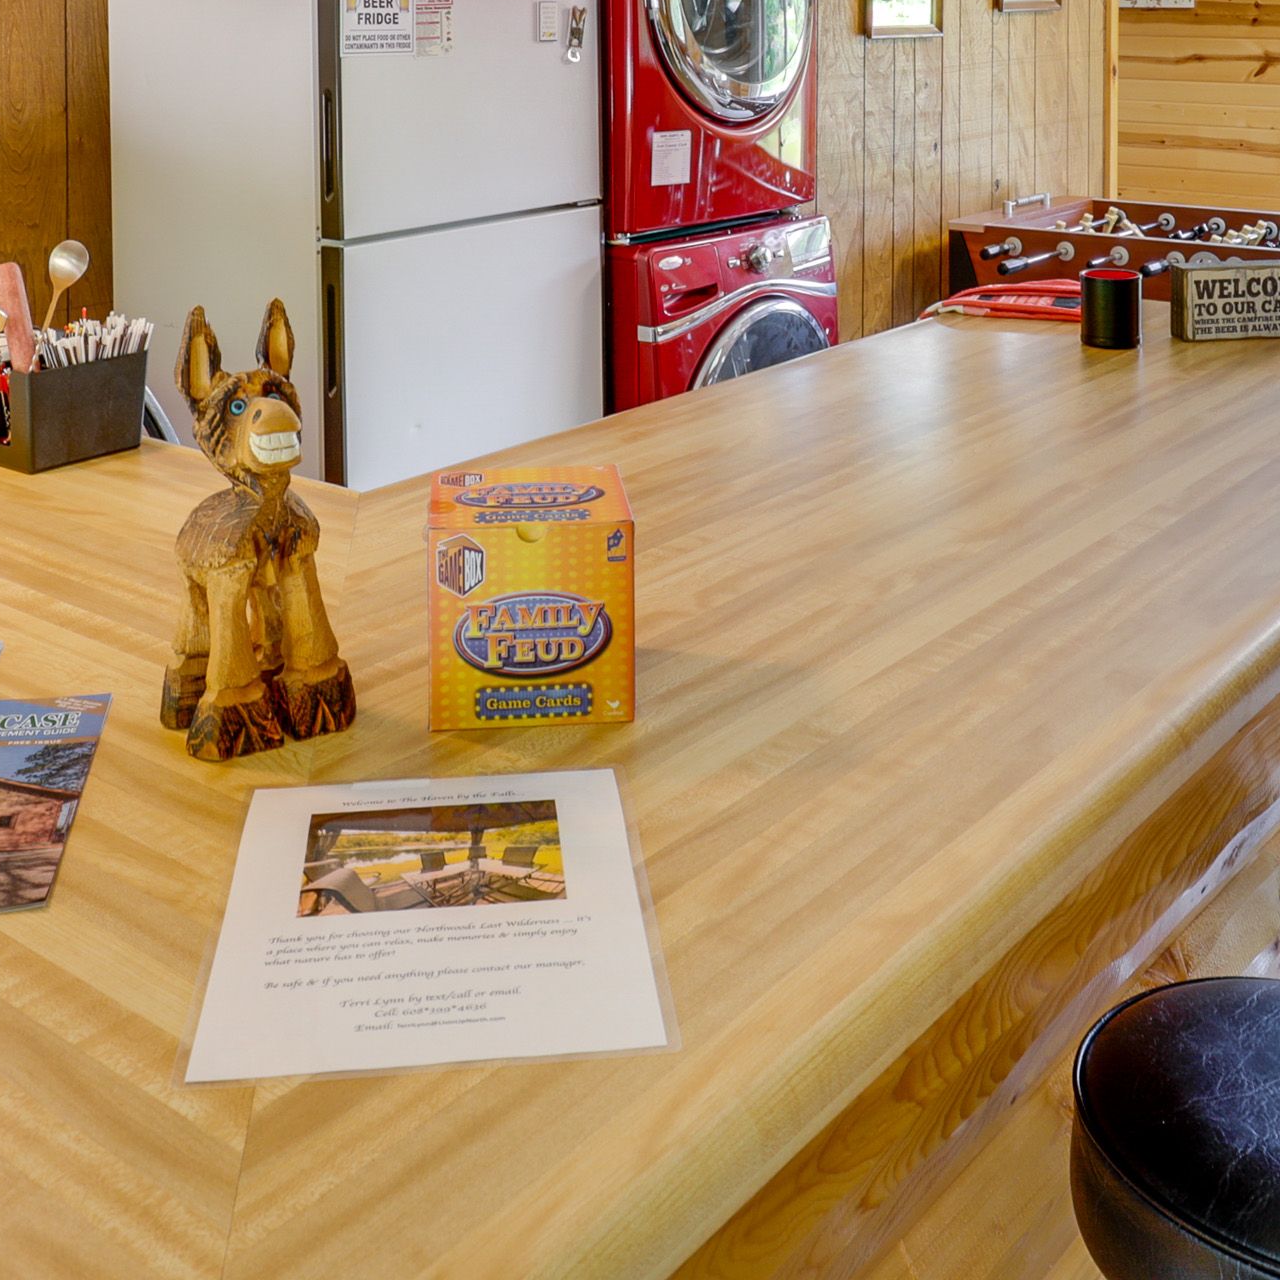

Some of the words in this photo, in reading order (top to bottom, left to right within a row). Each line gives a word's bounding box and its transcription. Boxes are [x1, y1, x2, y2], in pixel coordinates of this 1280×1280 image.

[358, 13, 399, 24] FRIDGE
[1195, 303, 1218, 316] TO
[1222, 301, 1256, 315] OUR
[464, 474, 482, 485] BOX
[468, 485, 594, 498] FAMILY
[486, 494, 580, 506] FEUD
[438, 550, 462, 595] GAME
[464, 550, 482, 591] BOX
[465, 600, 605, 638] FAMILY
[484, 633, 585, 668] FEUD
[486, 697, 531, 710] Game
[536, 695, 582, 708] Cards
[43, 728, 77, 736] GUIDE
[268, 936, 303, 944] Thank
[306, 935, 325, 944] you
[328, 932, 343, 941] for
[346, 930, 391, 938] choosing
